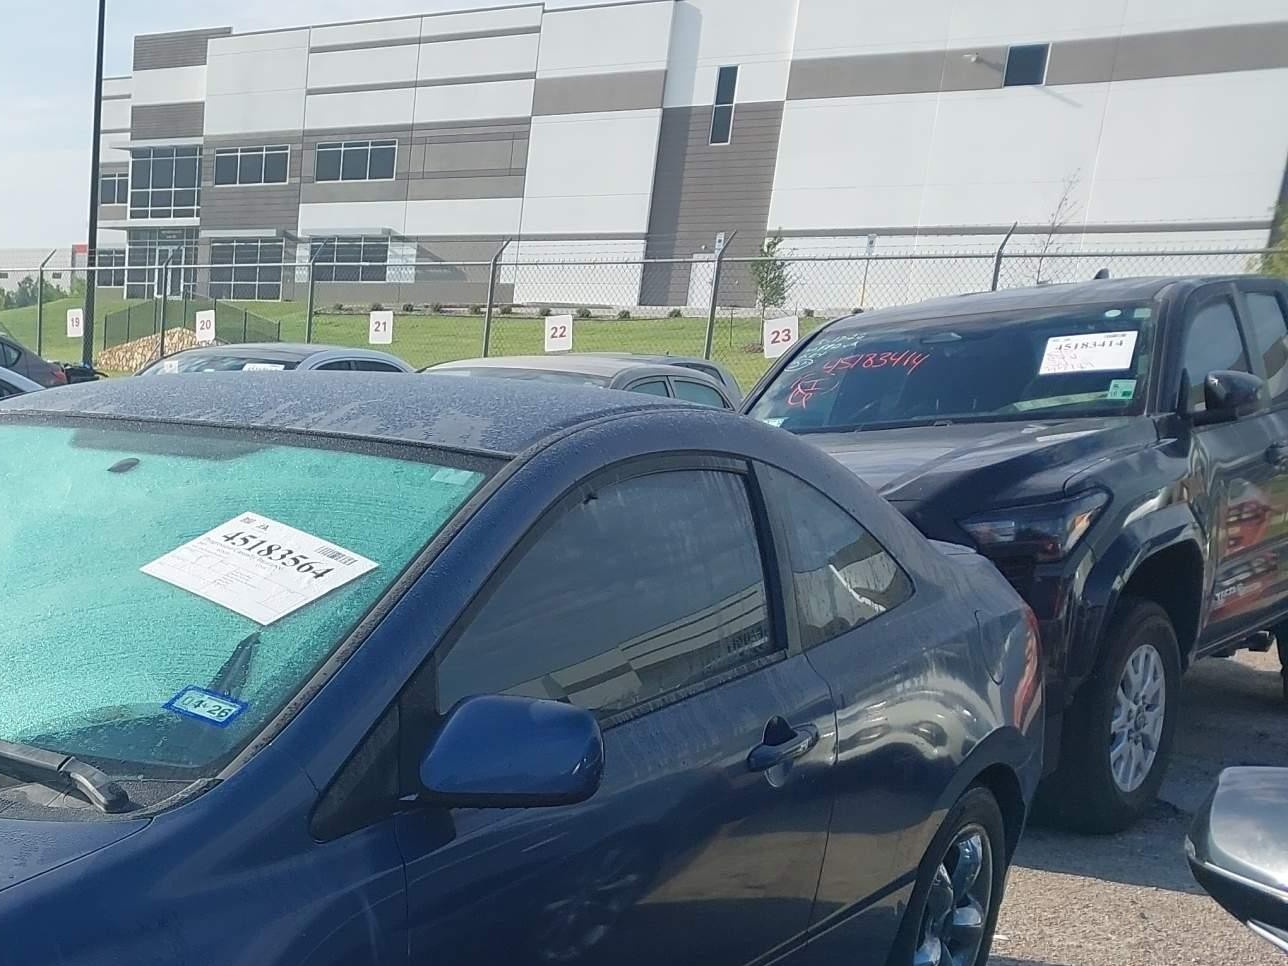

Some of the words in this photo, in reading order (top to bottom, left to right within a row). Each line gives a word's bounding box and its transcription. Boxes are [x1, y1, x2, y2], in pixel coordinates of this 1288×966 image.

[70, 317, 81, 328] 19
[199, 319, 212, 330] 20
[373, 320, 388, 333] 21
[550, 325, 568, 340] 22
[770, 328, 792, 345] 23
[1054, 339, 1124, 351] 45183414
[823, 350, 929, 376] 45183414
[222, 531, 335, 580] 45183564
